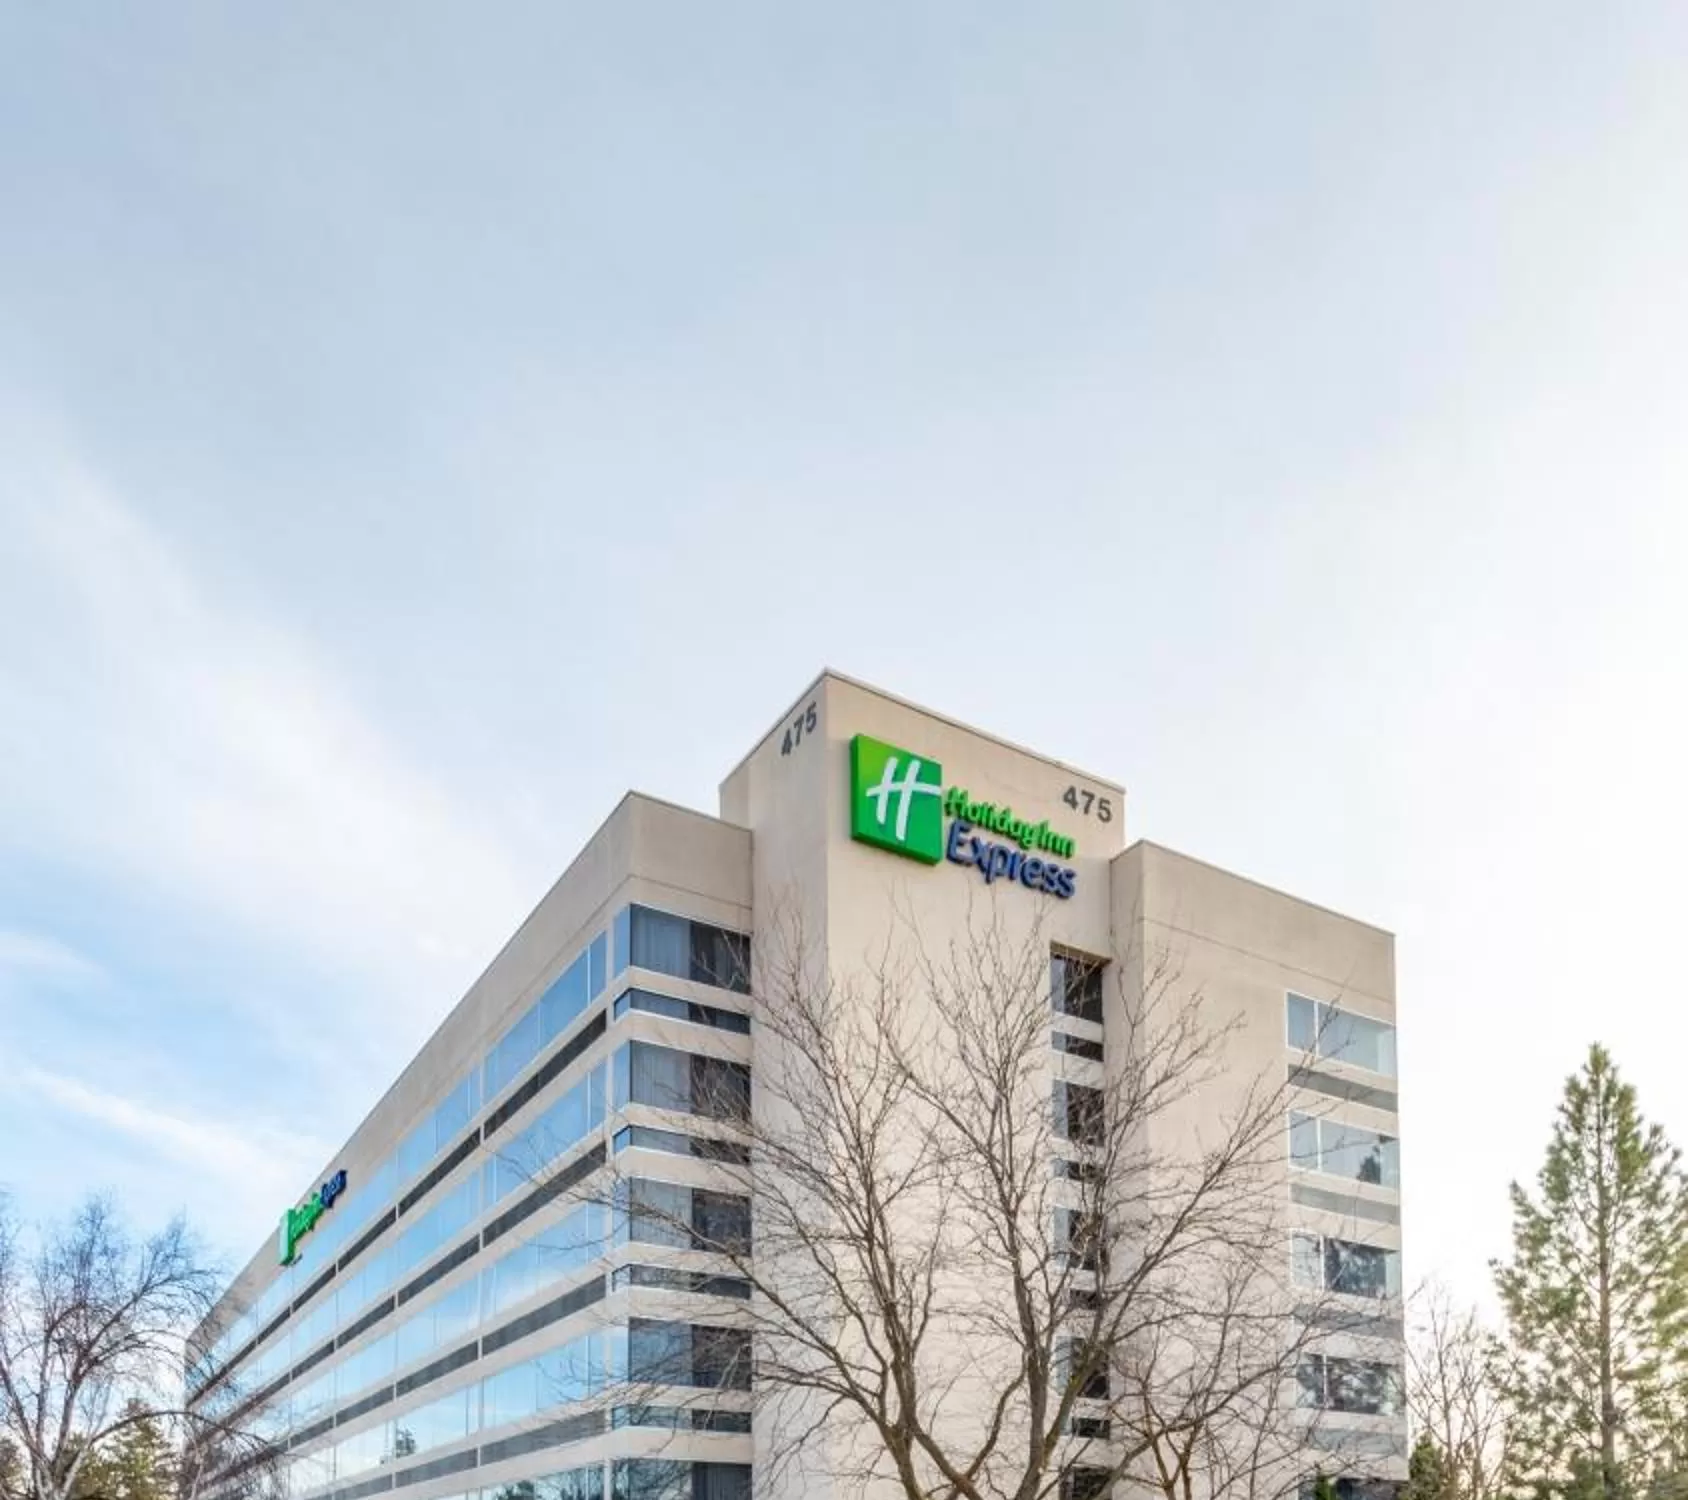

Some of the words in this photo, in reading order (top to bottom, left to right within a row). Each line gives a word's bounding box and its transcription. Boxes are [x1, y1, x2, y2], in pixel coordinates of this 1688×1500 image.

[781, 700, 817, 757] 475
[1063, 785, 1112, 824] 475
[946, 818, 1076, 899] Express
